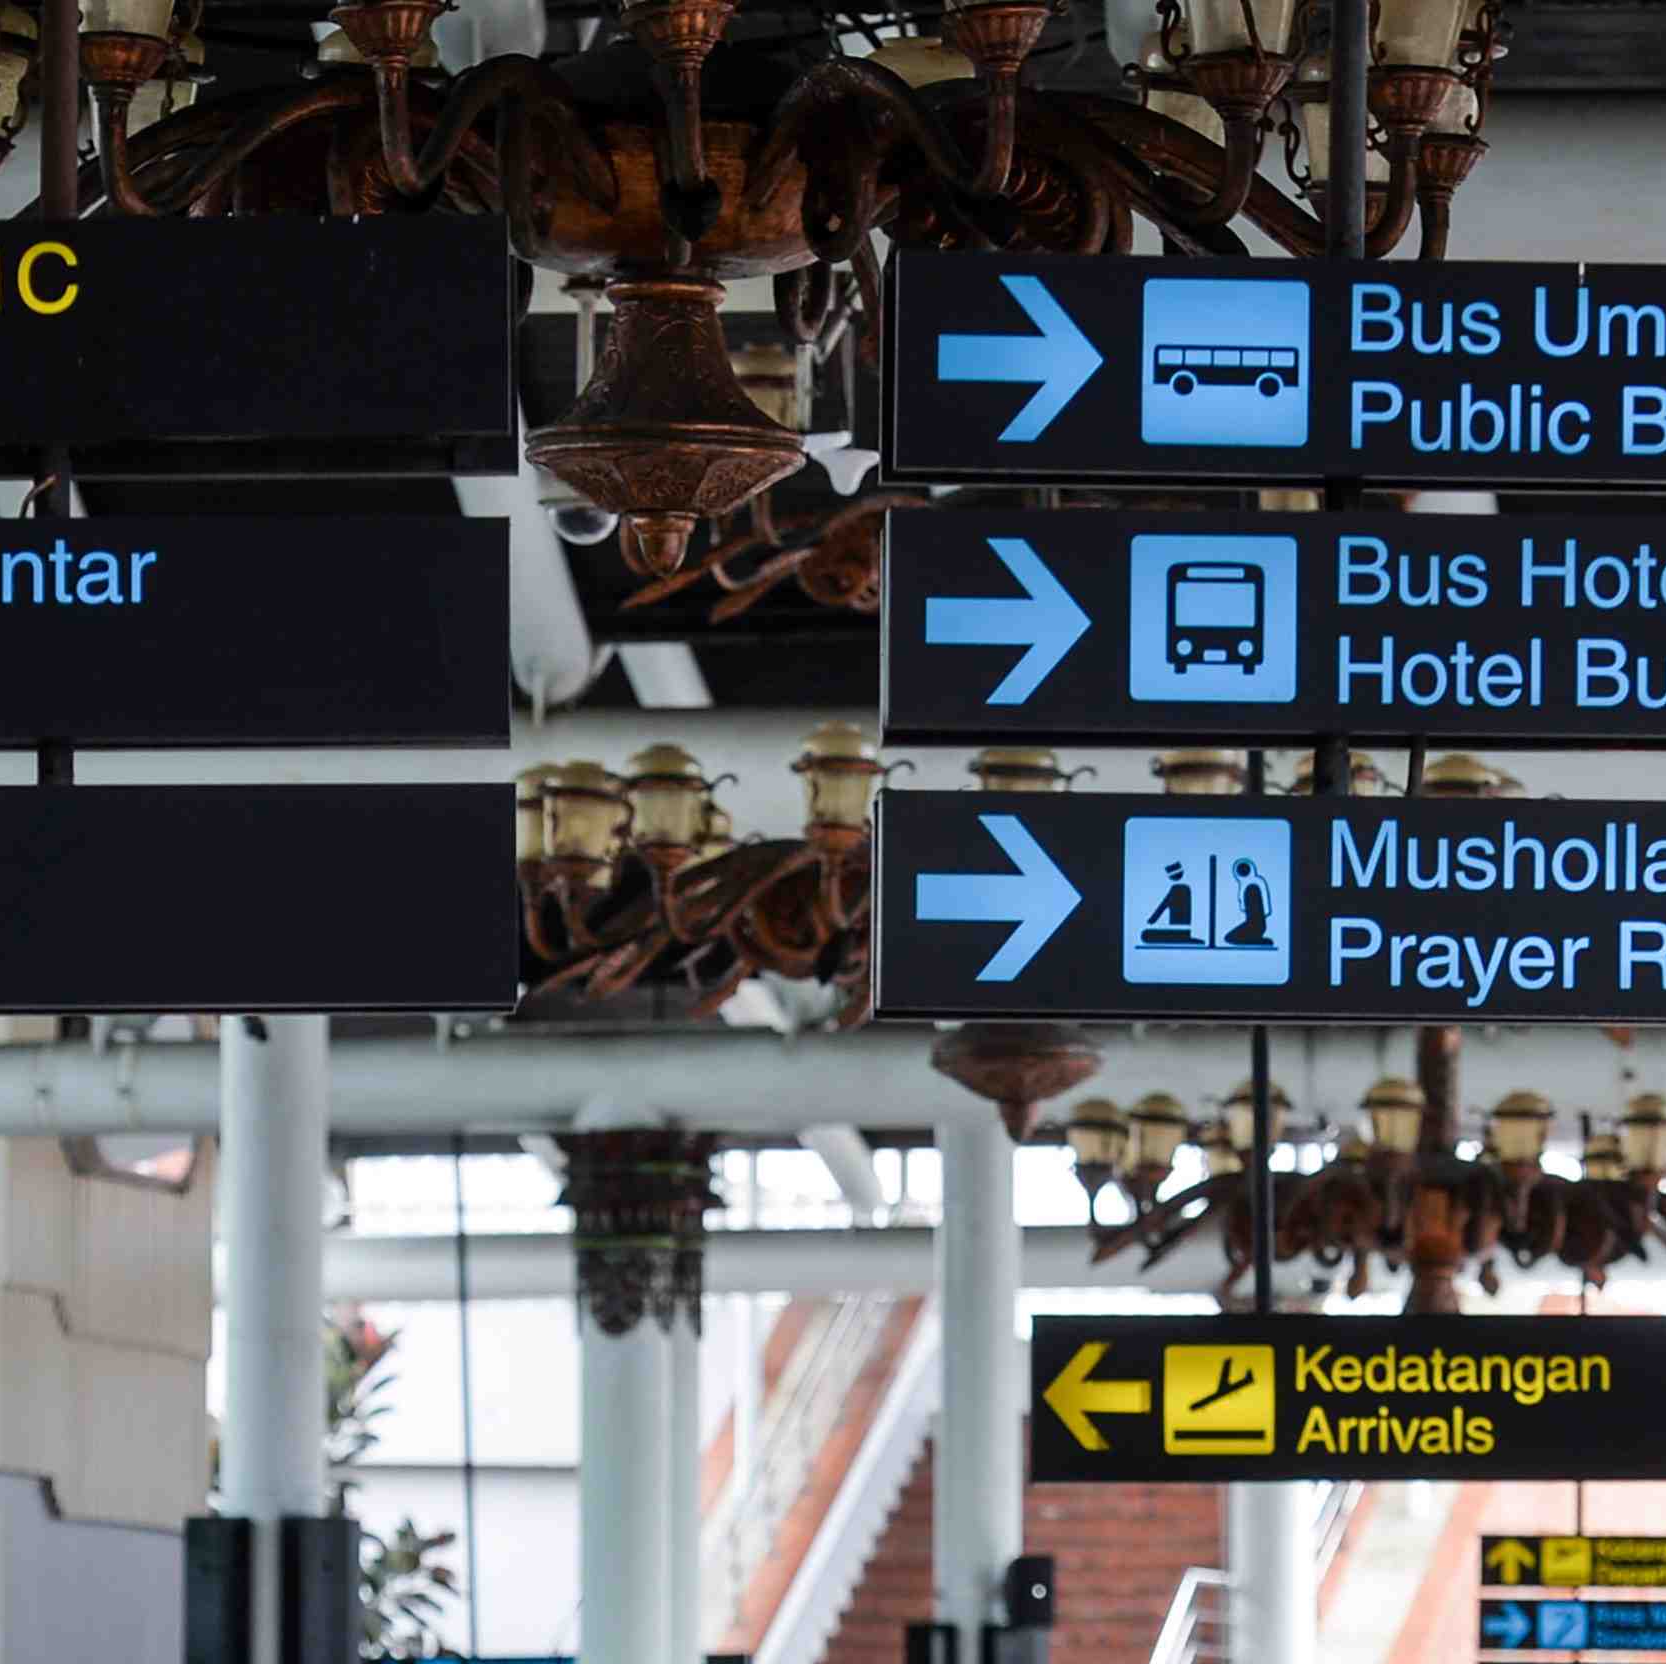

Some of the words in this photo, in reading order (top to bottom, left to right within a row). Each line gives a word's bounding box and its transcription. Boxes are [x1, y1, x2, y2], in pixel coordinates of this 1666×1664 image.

[1351, 283, 1502, 355] Bus
[1351, 380, 1592, 455] Public
[1338, 535, 1489, 608] Bus
[1338, 635, 1542, 708] Hotel
[1330, 916, 1591, 1006] Prayer
[1295, 1345, 1611, 1405] Kedatangan
[1297, 1406, 1495, 1454] Arrivals
